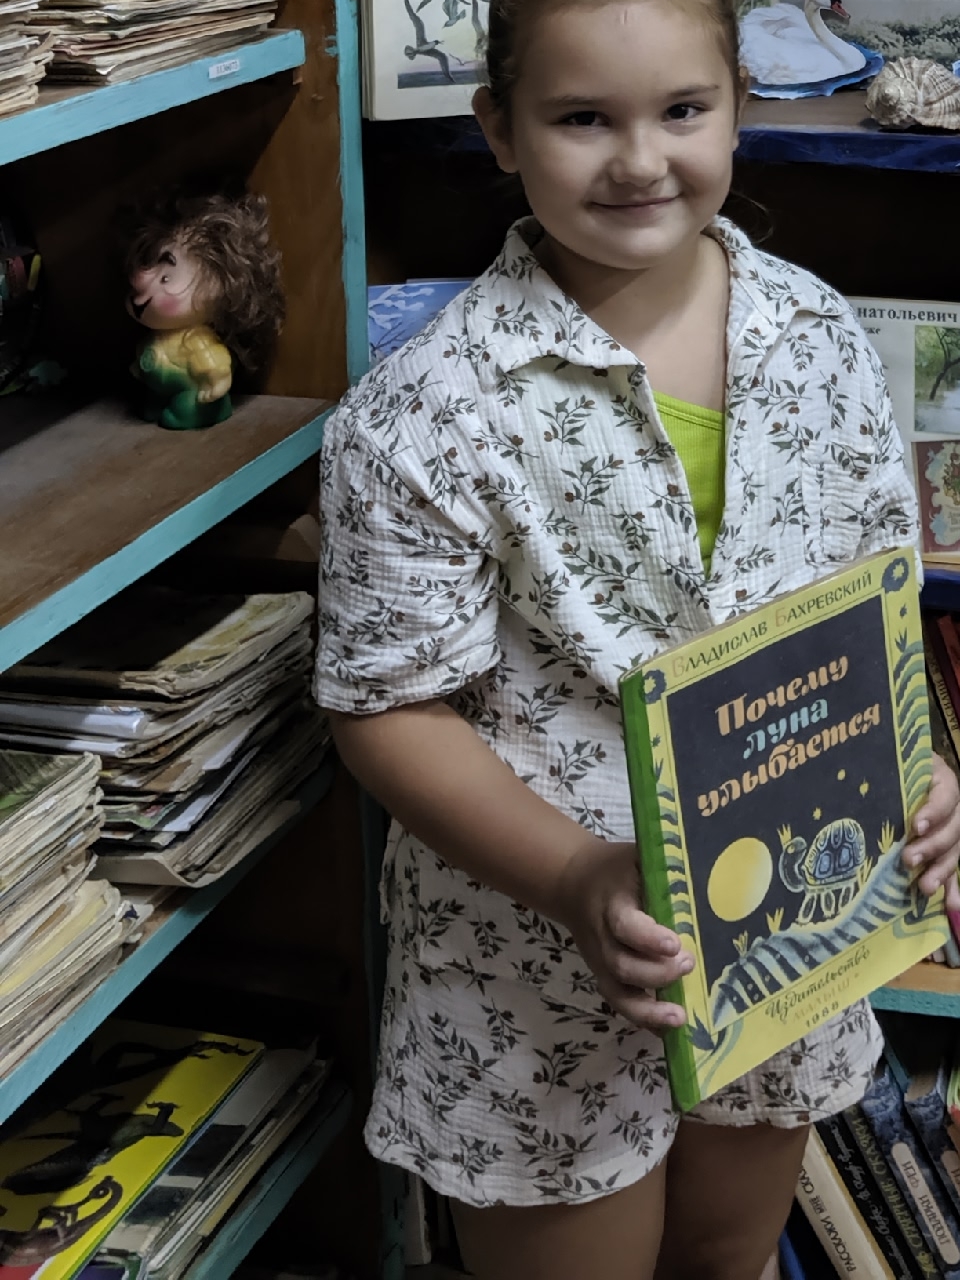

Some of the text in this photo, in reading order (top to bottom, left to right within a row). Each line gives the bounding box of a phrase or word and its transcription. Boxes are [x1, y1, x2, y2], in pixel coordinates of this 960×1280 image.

[854, 307, 957, 323] натольевич
[671, 570, 873, 678] ВЛАДИСЛАВ БАХРЕВСКИЙ
[714, 655, 848, 737] Почему
[743, 697, 828, 760] луна
[697, 703, 881, 818] улыбается
[765, 944, 871, 1021] Издательство
[805, 1000, 840, 1028] 1988
[849, 1115, 889, 1175] СКАЗКИ
[810, 1195, 857, 1273] РАССКАЖИ МНЕ
[881, 1178, 923, 1248] СЕВЕРНЫЕ
[902, 1160, 950, 1246] ПОДАРКИ ФЕИ
